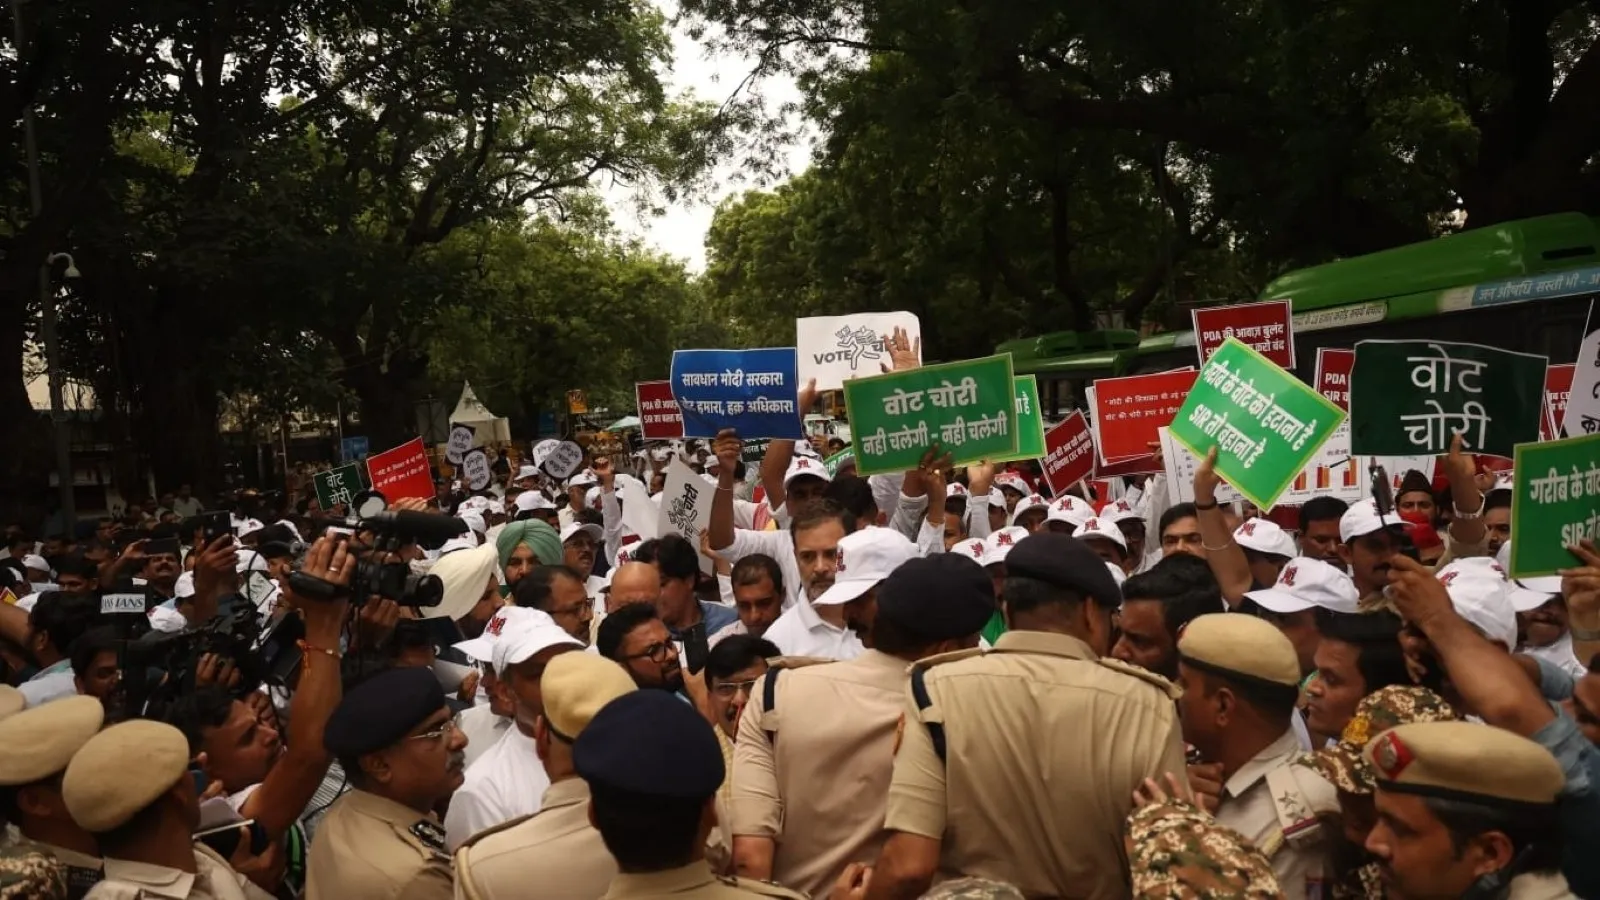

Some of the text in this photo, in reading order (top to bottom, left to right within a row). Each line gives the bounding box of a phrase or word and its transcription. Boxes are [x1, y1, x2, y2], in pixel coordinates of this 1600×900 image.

[1204, 330, 1221, 341] PDA
[1222, 326, 1234, 339] की
[814, 350, 851, 364] VOTE
[1406, 343, 1488, 393] वोट
[682, 372, 717, 387] सावधान
[720, 369, 743, 388] मोदी
[1221, 368, 1240, 394] के
[1230, 378, 1255, 407] वोट
[1325, 373, 1346, 385] PDA
[882, 376, 978, 416] वोट चोरी
[1249, 393, 1274, 420] को
[889, 420, 928, 449] चलेगी
[968, 410, 1008, 441] चलेगी
[1189, 404, 1267, 469] SIR तो बहाना है
[1260, 404, 1305, 442] हटाना
[1292, 419, 1317, 451] है
[1400, 400, 1492, 450] चोरी
[325, 470, 345, 488] वोट
[1530, 466, 1568, 504] गरीब
[1570, 464, 1583, 498] के
[682, 482, 699, 513] चोरी
[1561, 522, 1586, 549] SIR
[115, 597, 144, 608] IANS
